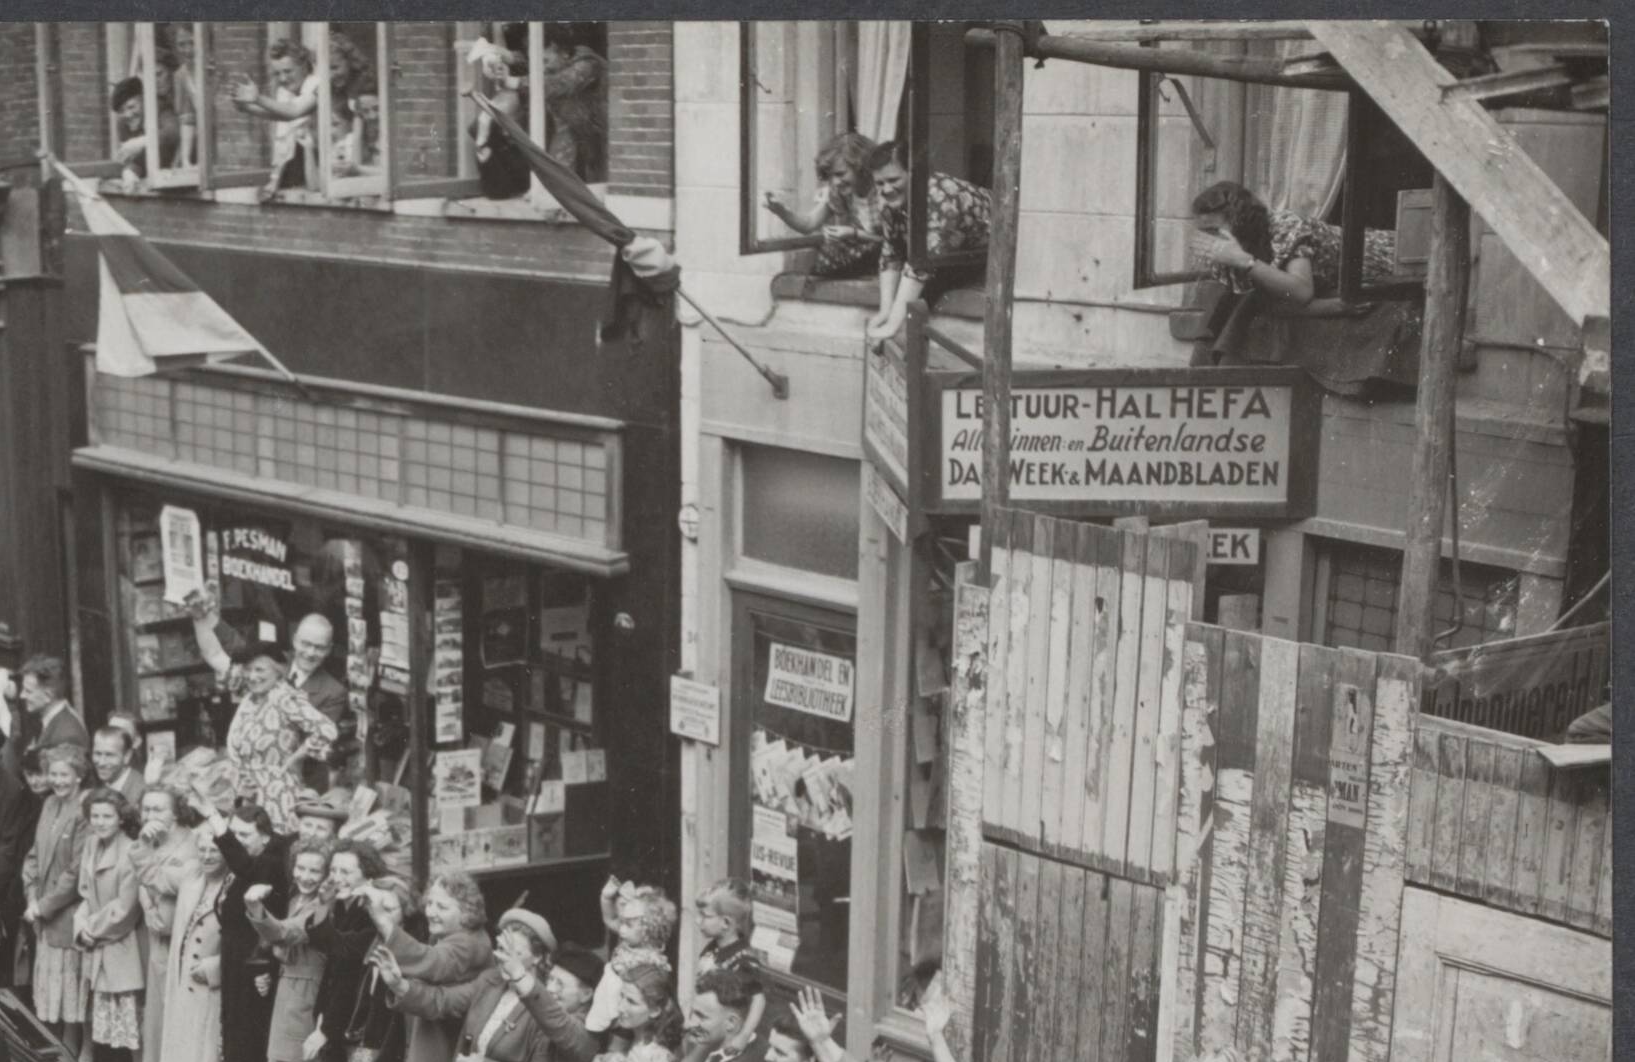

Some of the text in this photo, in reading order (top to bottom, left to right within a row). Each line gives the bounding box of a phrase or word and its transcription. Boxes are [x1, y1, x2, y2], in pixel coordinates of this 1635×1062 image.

[956, 387, 1271, 419] LETUUR-HAL HEFA
[1068, 439, 1085, 452] en
[1086, 422, 1266, 453] Buitenlandse
[1069, 471, 1082, 486] &
[1084, 458, 1280, 486] MAANDBLADEN
[222, 555, 296, 592] BOEKHANDEL
[774, 647, 850, 686] BOEKHANDEL EN
